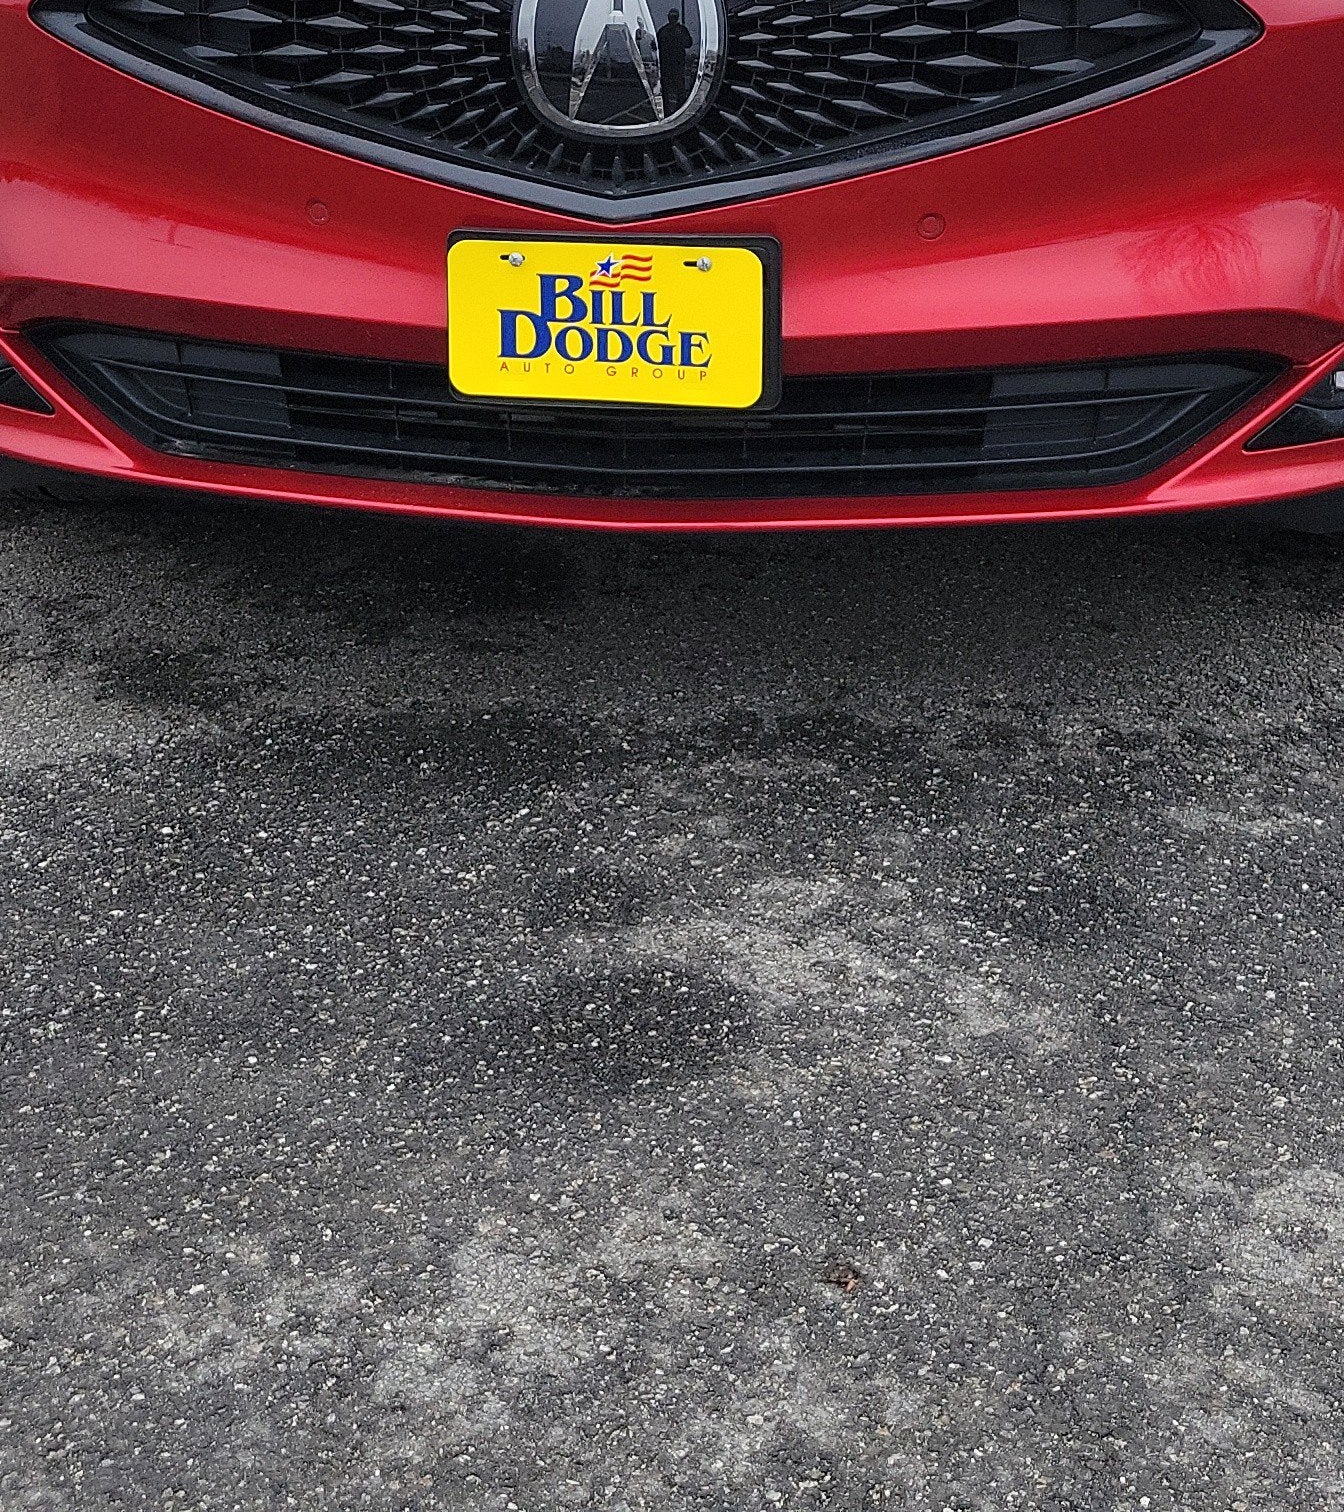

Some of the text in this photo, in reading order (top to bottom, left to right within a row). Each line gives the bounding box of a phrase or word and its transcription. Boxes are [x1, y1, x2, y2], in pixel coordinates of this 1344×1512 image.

[536, 273, 672, 329] BILL
[497, 308, 713, 369] DODGE
[500, 361, 708, 382] AUTO GROUP
